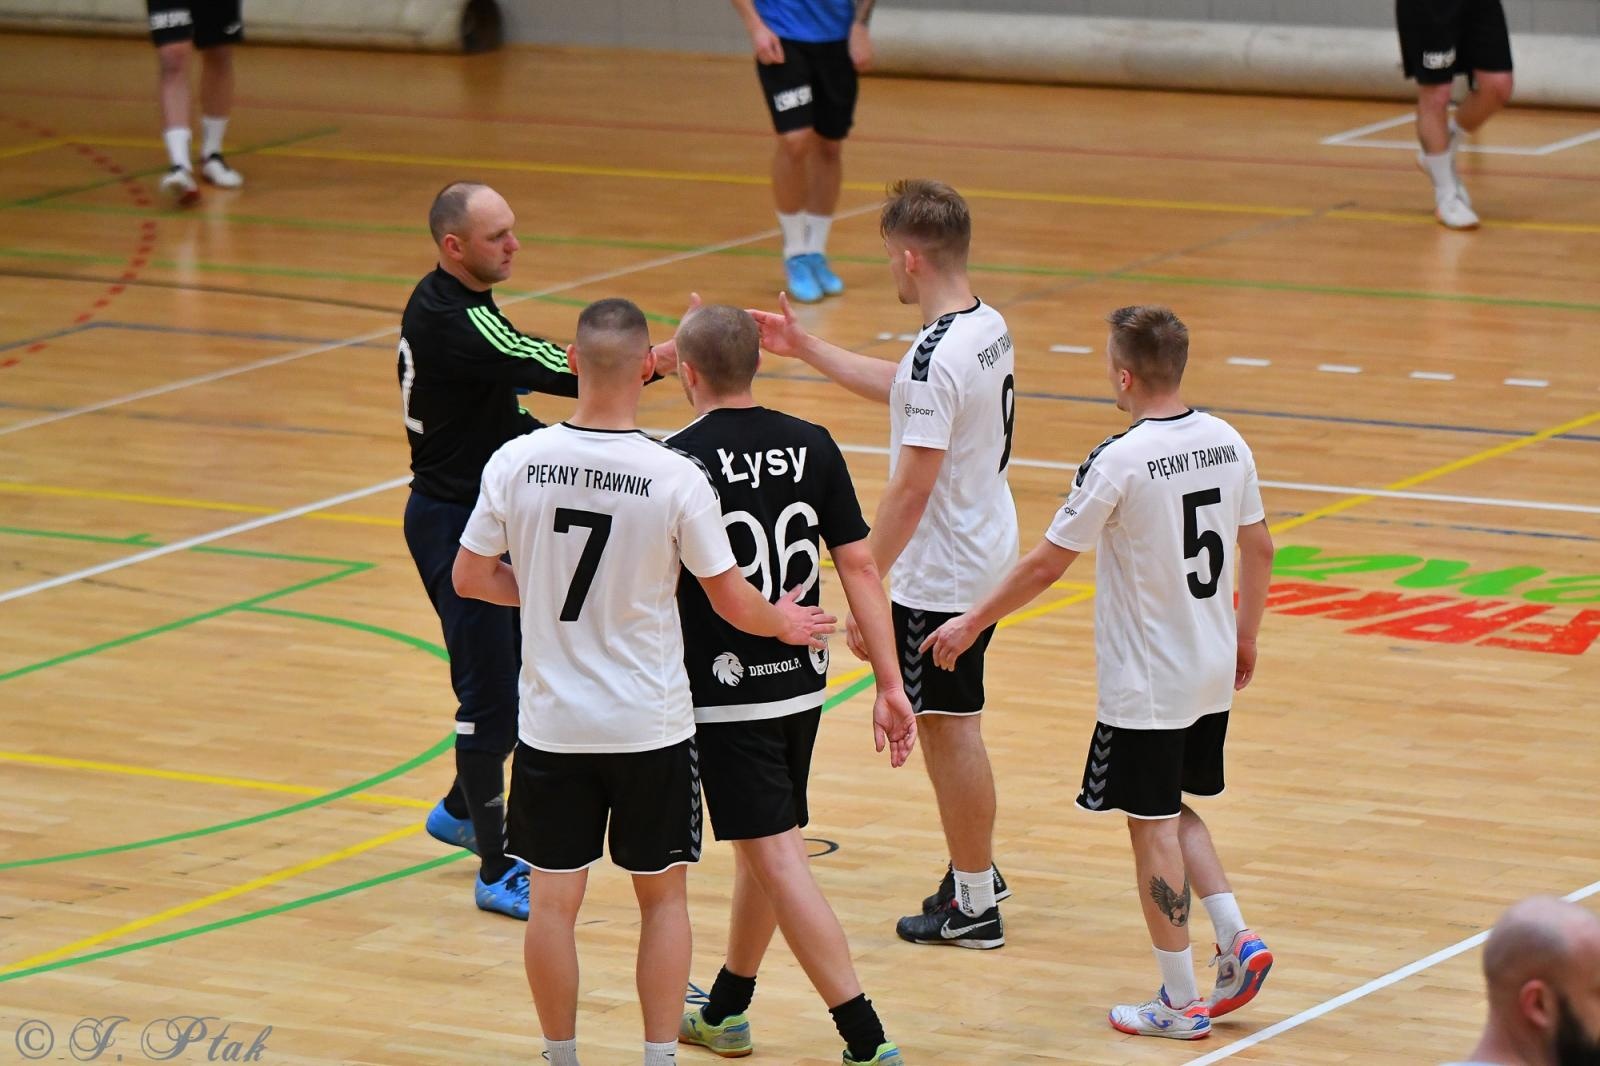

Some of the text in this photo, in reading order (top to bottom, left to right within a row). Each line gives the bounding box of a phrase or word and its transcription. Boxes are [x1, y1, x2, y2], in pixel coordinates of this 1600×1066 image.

[526, 464, 653, 498] PIĘKNY TRAWNIK
[716, 446, 807, 489] Łysy
[1146, 444, 1240, 481] PIĘKNY TRAWNIK
[553, 507, 613, 622] 7
[721, 501, 820, 604] 96
[1182, 487, 1225, 600] 5
